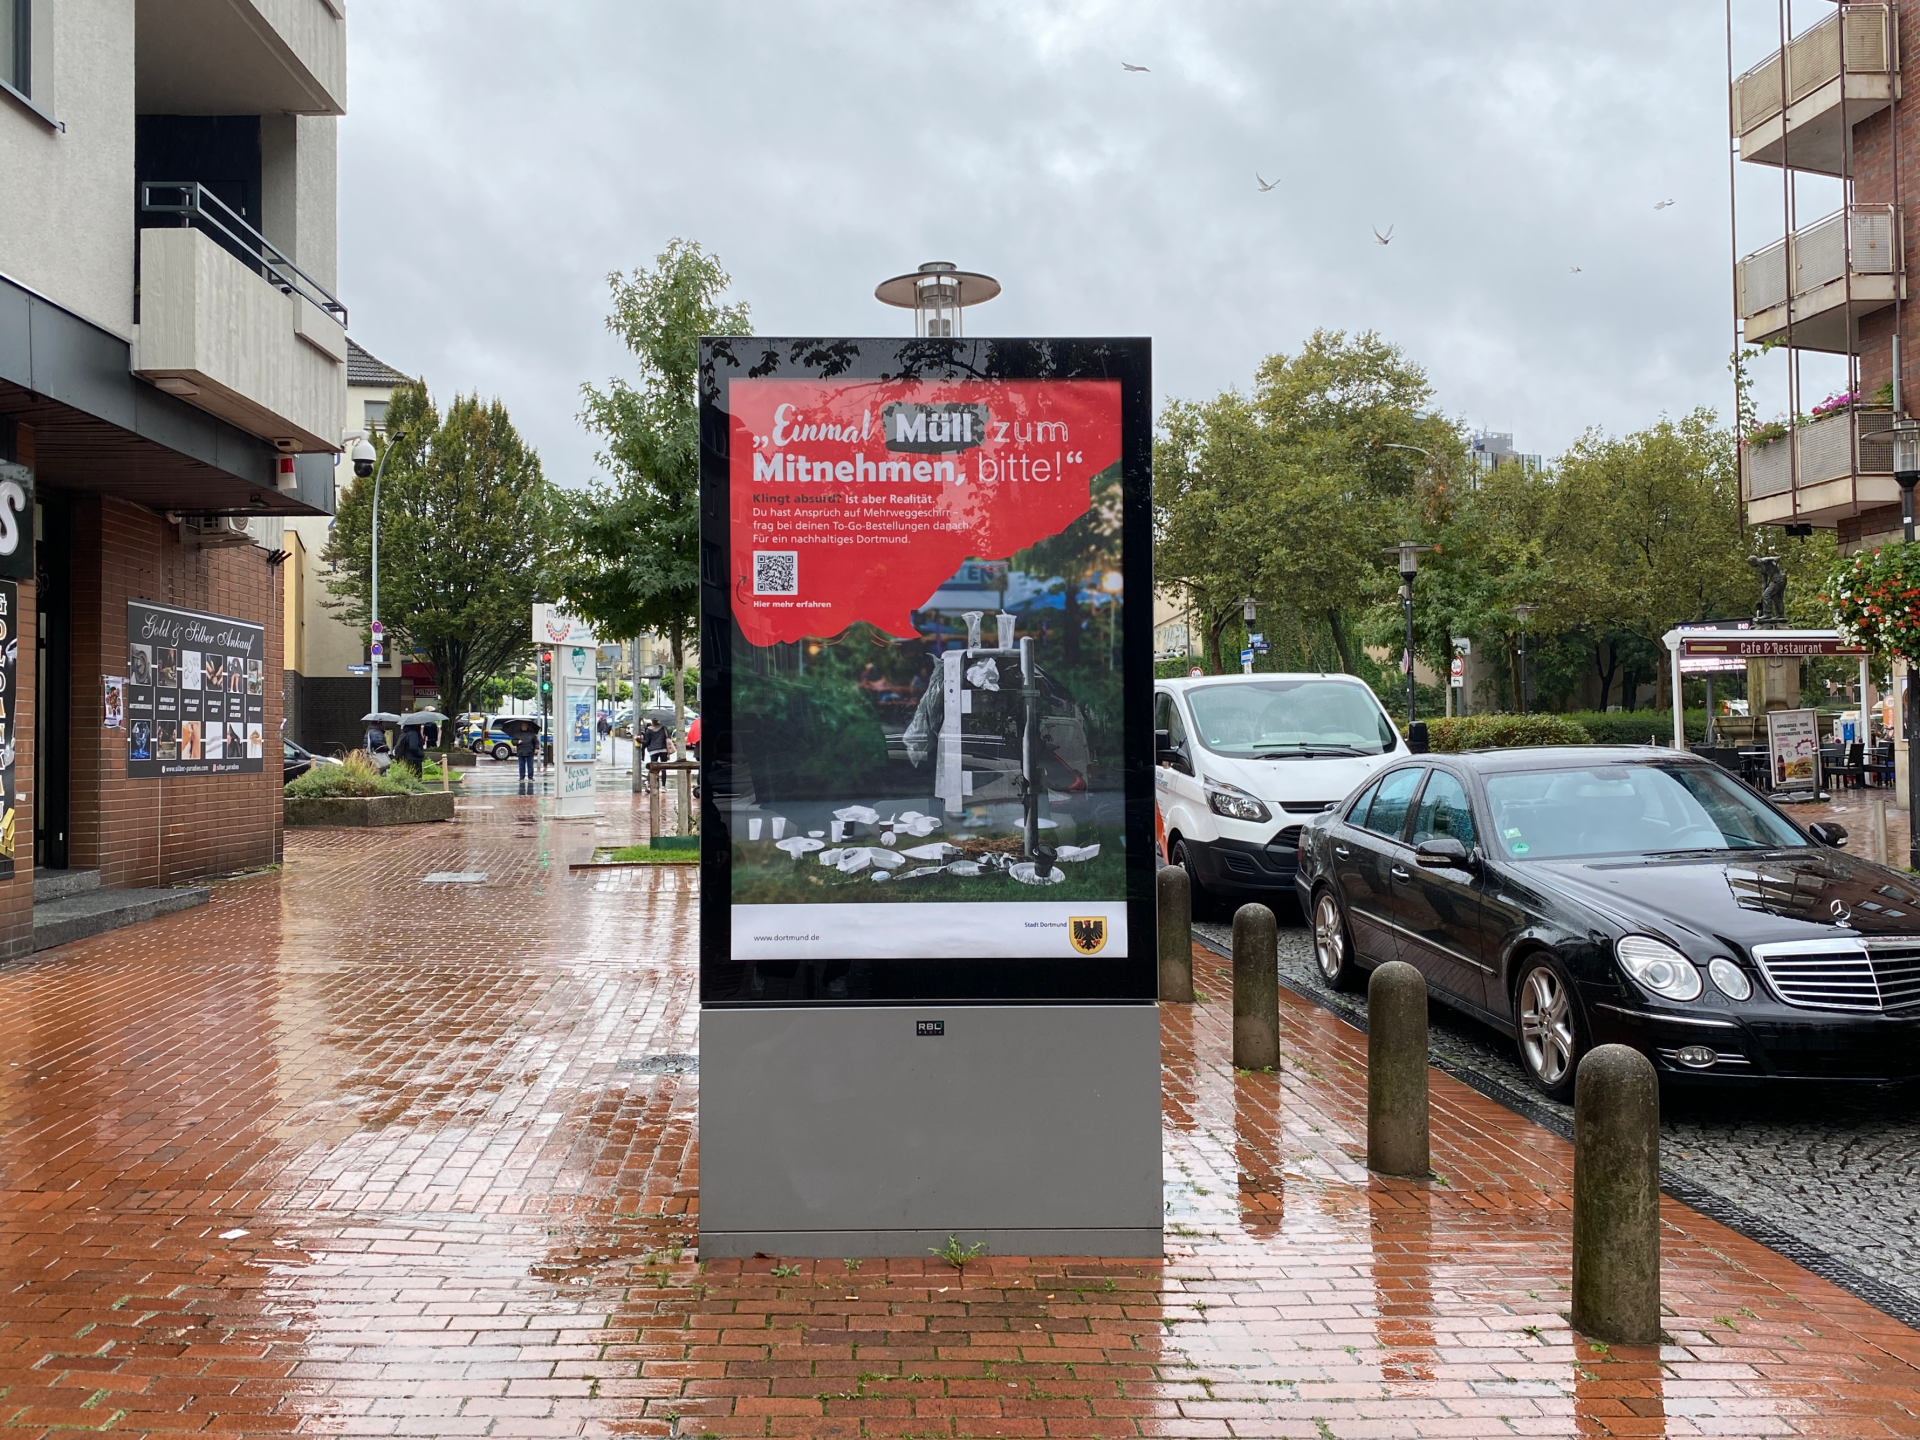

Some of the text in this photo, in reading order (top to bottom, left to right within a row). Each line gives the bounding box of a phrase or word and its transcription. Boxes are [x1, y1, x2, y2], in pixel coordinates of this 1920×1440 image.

[752, 402, 1069, 448] „Einmal Müll zum
[753, 451, 1083, 486] Mitnehmen, bitte!“
[753, 494, 935, 505] Klingt absurd? Ist aber Realität.
[753, 507, 767, 517] Du
[770, 507, 791, 517] hast
[794, 508, 841, 519] Anspruch
[844, 508, 861, 517] auf
[863, 508, 950, 519] Mehrweggeschirr
[753, 521, 972, 532] frag bei deinen To-Go-Bestellungen danach.
[753, 534, 911, 546] Für ein nachhaltiges Dortmund.
[141, 612, 255, 657] Gold & Silber Ankauf
[1740, 641, 1823, 655] Cafe & Restaurant
[567, 766, 589, 780] besser
[565, 776, 592, 793] ist bunt
[753, 933, 820, 942] www.dortmund.de
